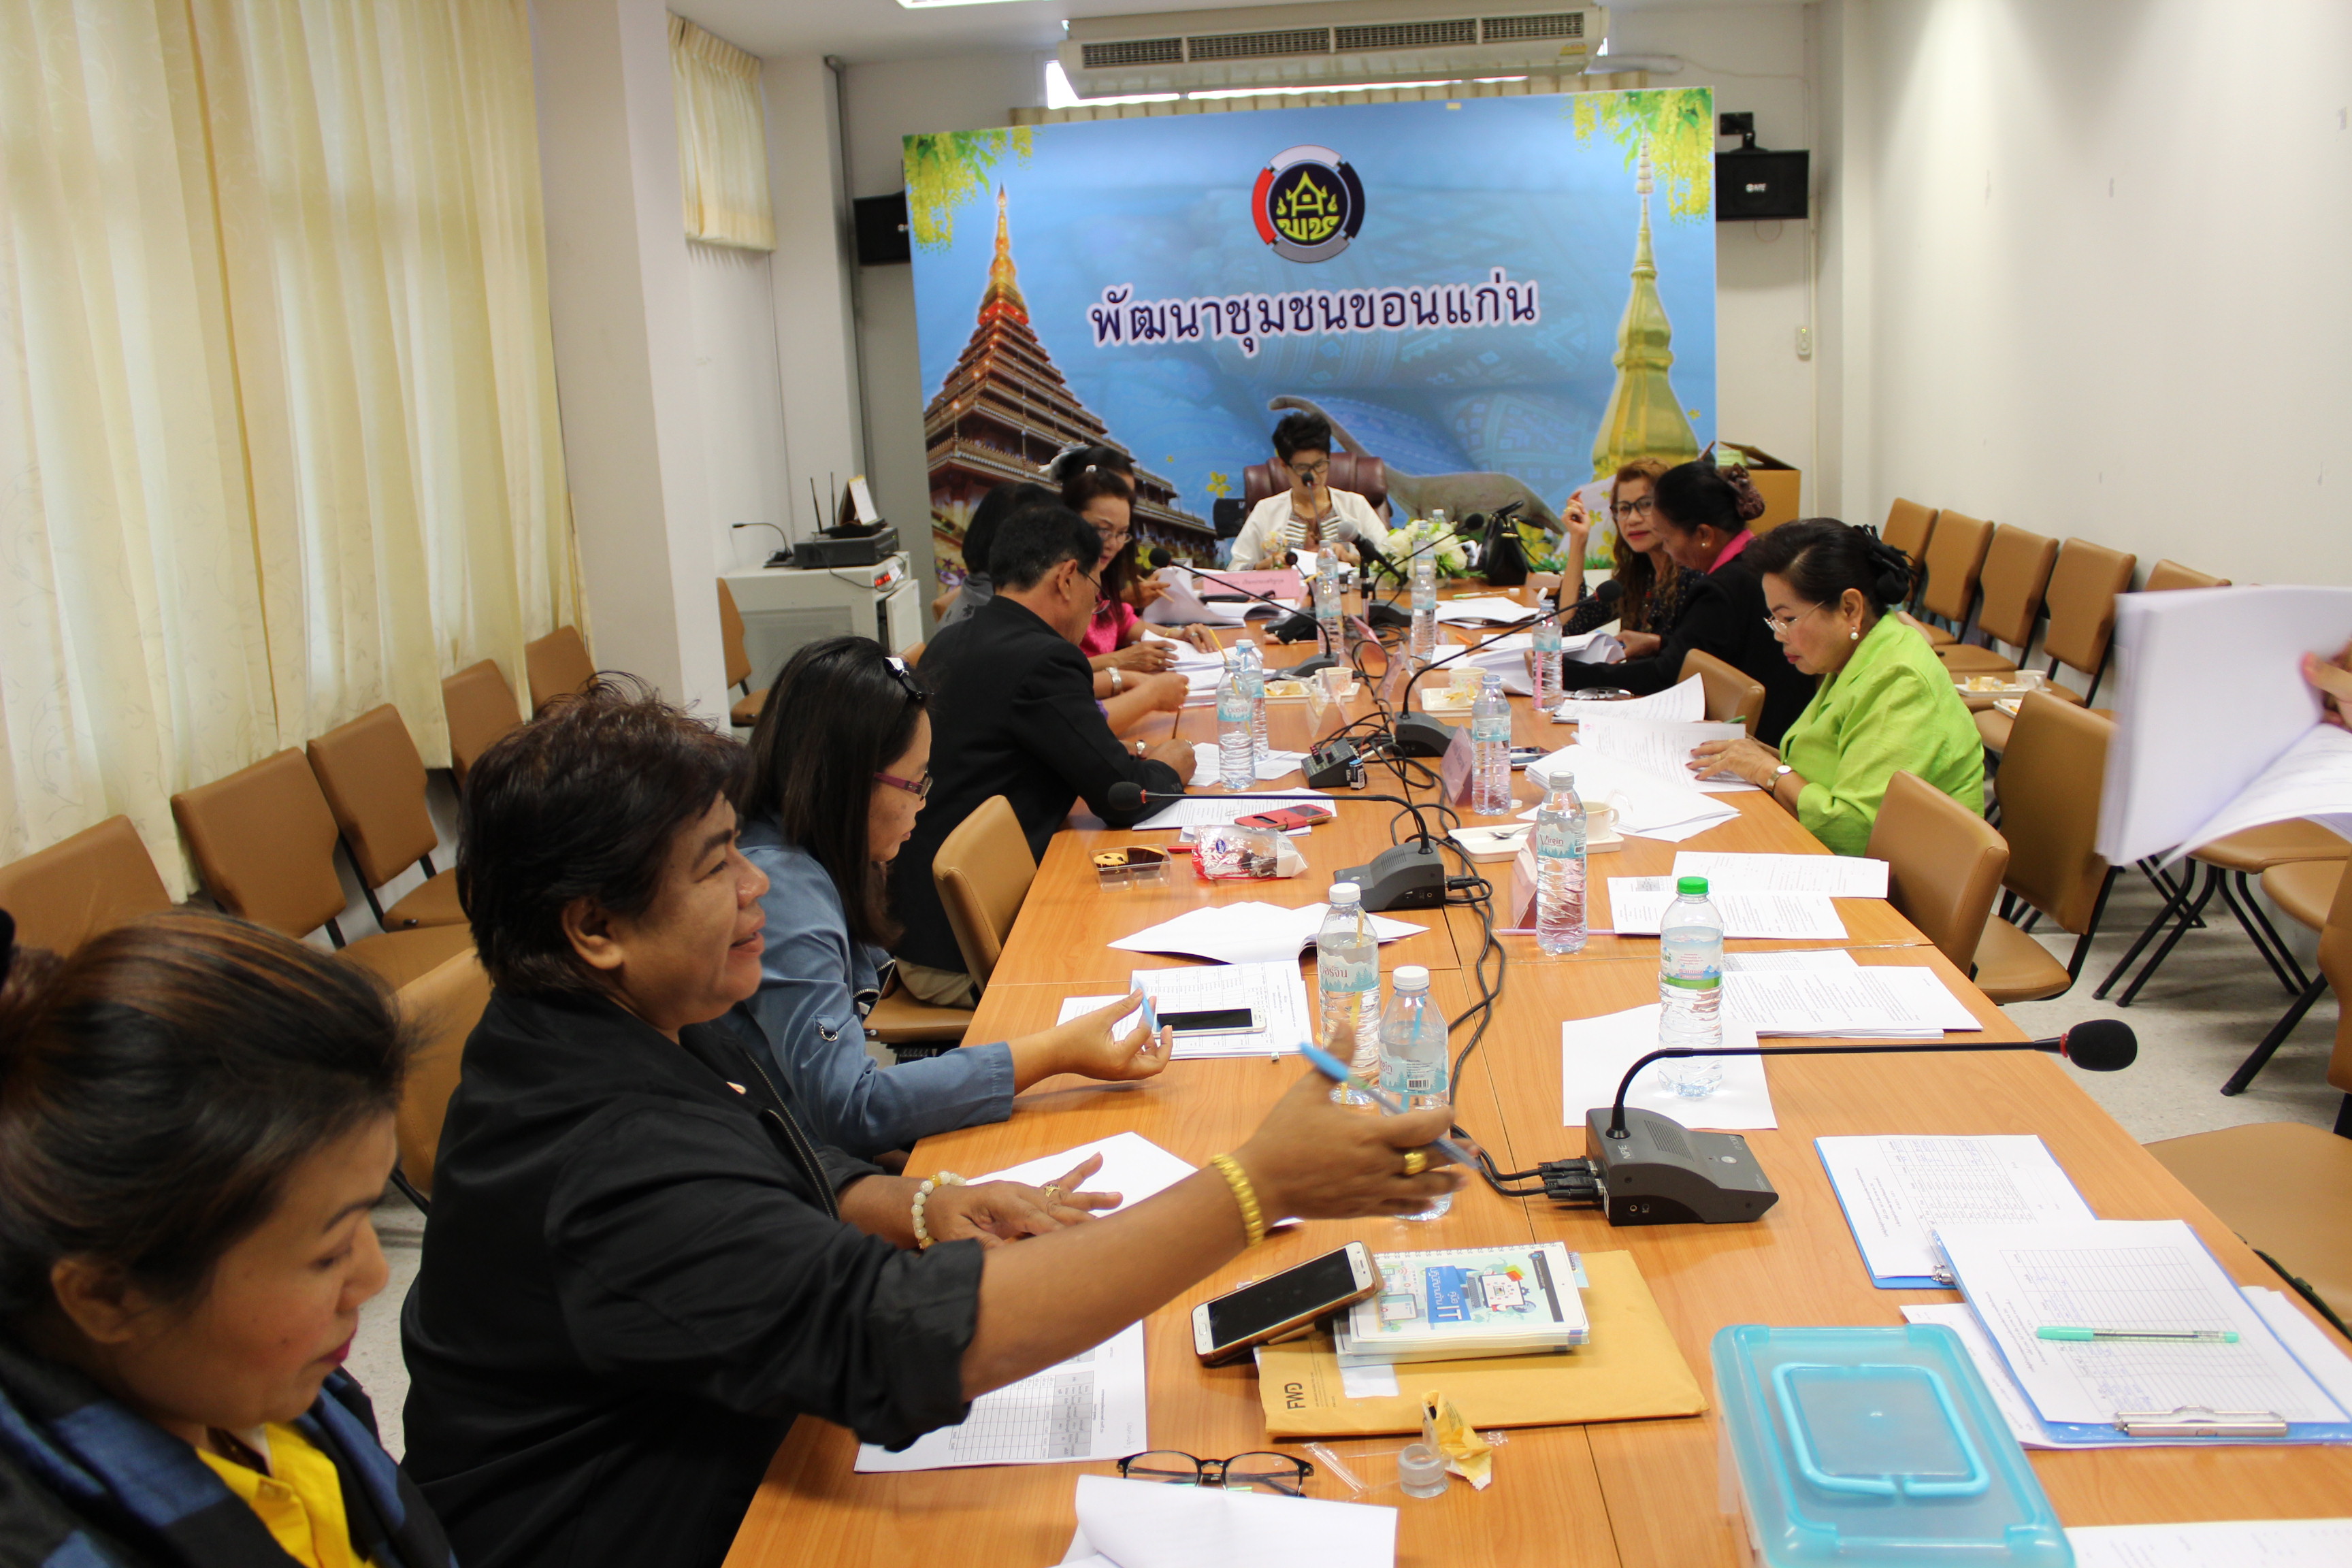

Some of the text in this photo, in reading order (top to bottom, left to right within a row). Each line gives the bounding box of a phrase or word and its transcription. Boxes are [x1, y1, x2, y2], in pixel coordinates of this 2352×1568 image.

[1090, 272, 1536, 354] พัฒนาชุมชนขอนแก่น
[1539, 834, 1564, 846] Virgin
[1617, 1144, 1632, 1160] NPE
[1436, 1305, 1463, 1320] IT
[1284, 1382, 1307, 1409] FWD
